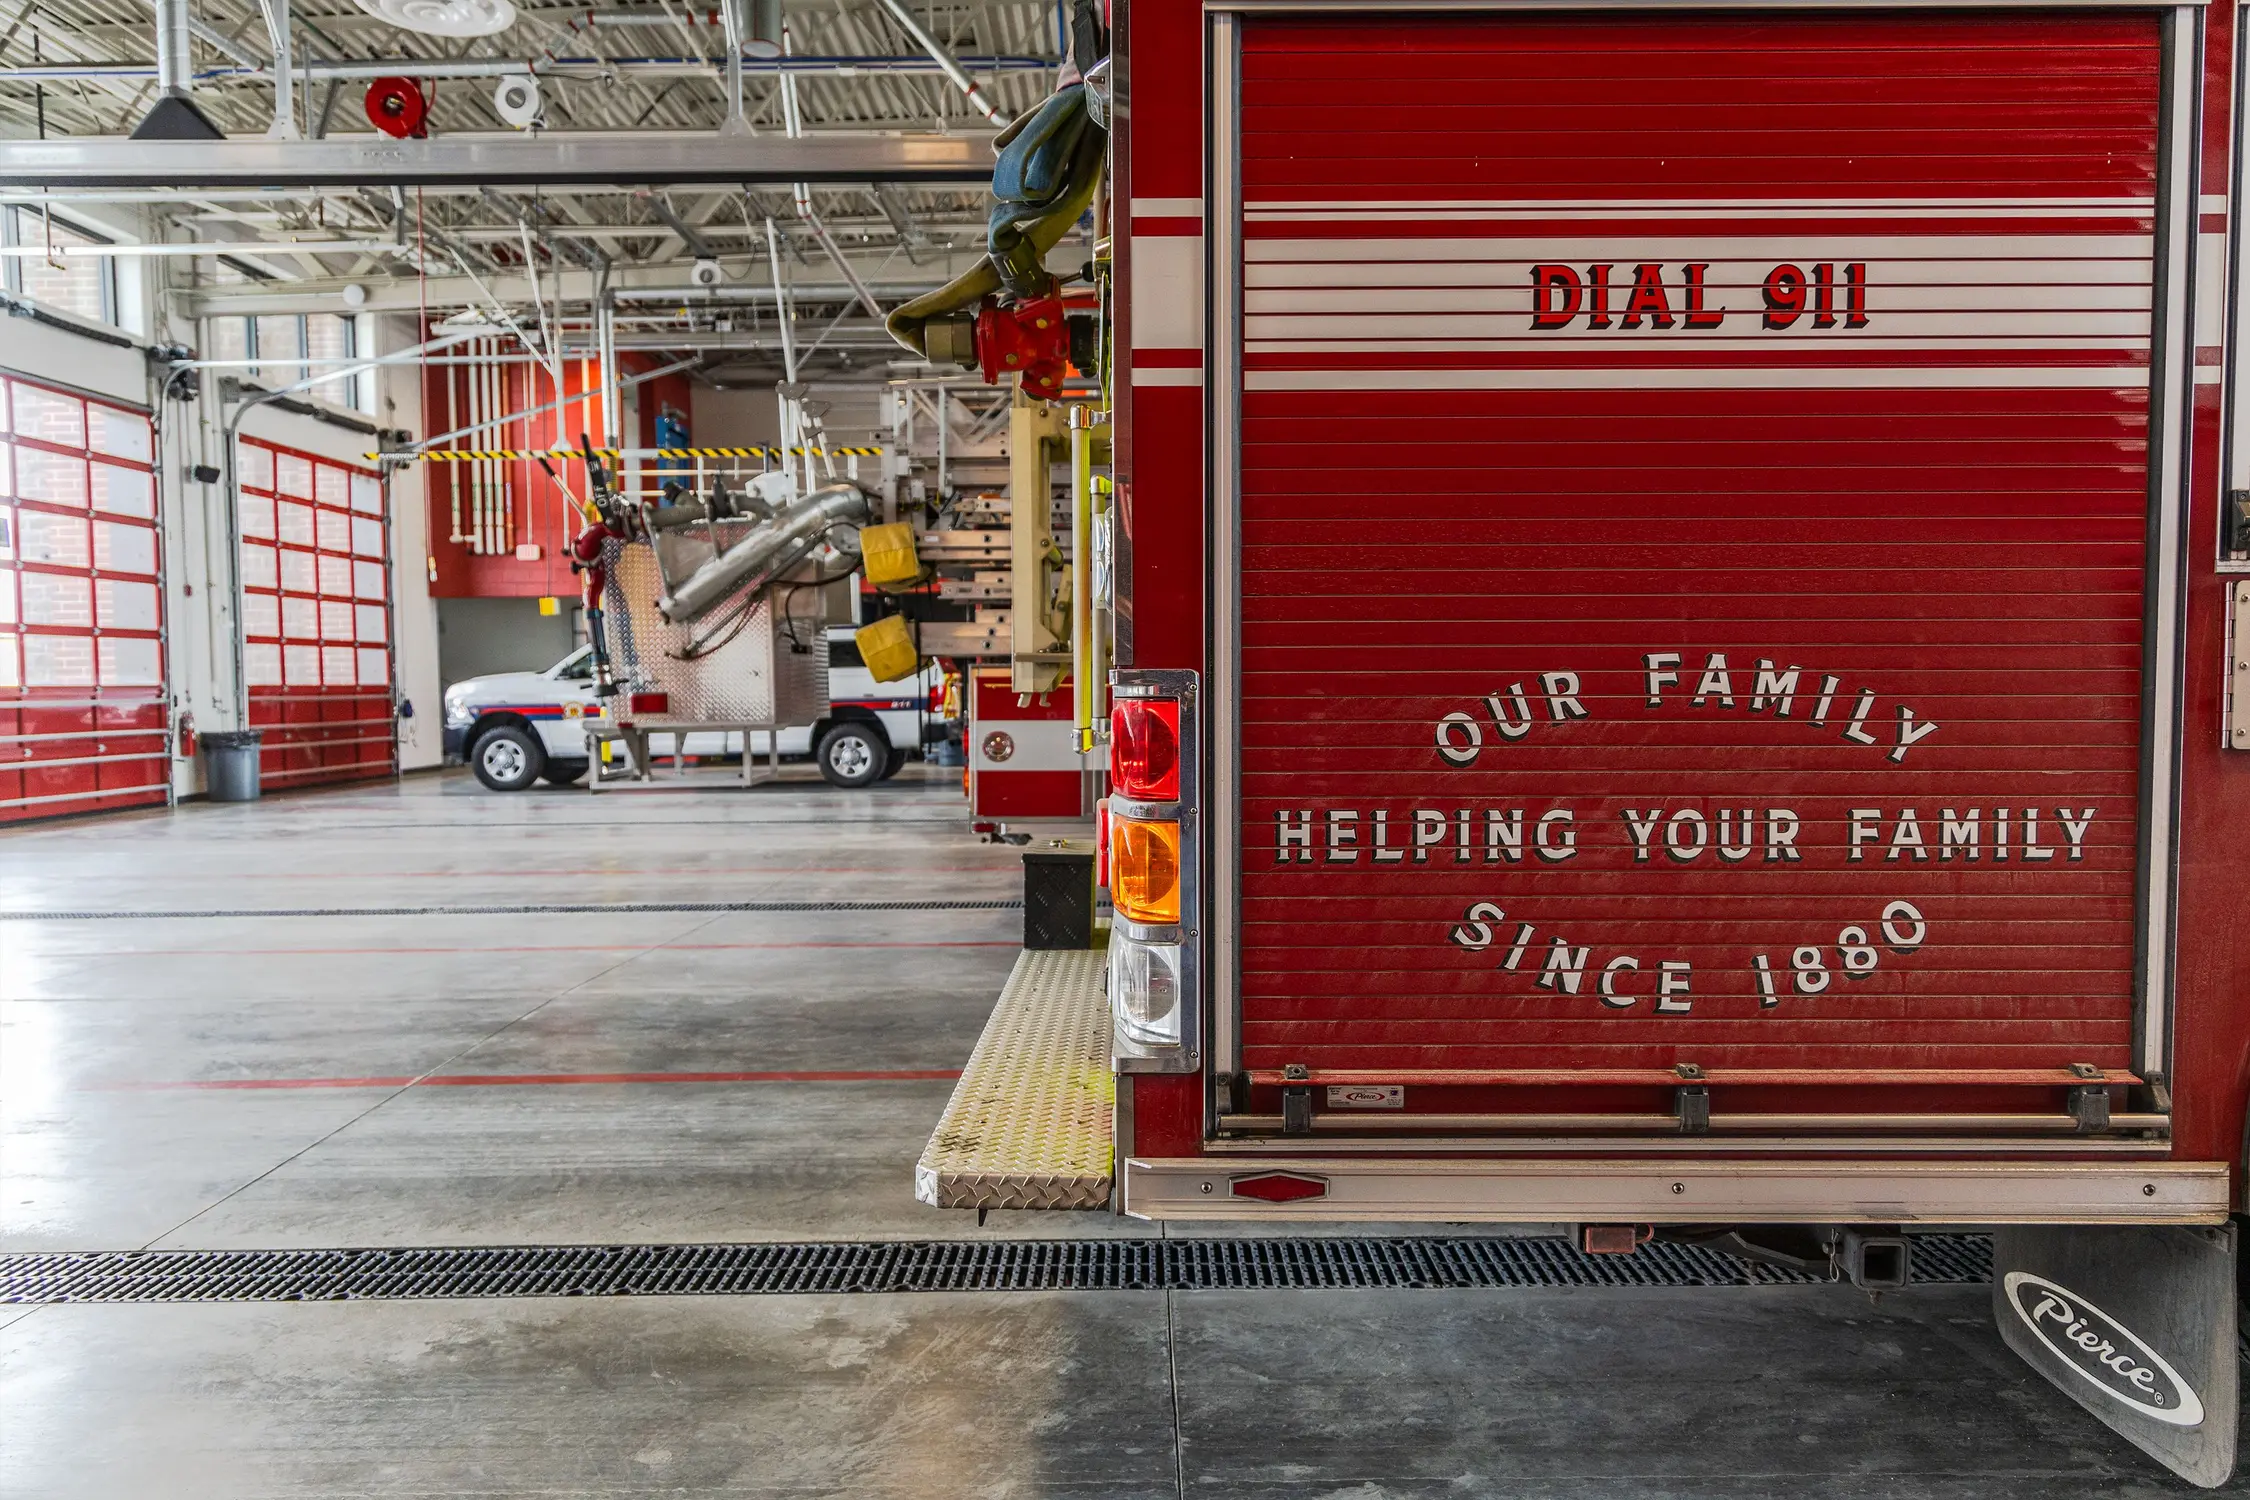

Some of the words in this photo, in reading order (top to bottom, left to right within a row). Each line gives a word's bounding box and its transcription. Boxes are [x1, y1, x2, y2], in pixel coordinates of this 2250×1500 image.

[1529, 264, 1725, 331] DIAL
[1762, 263, 1870, 331] 911
[593, 484, 609, 509] OFF
[1434, 668, 1591, 768] OUR
[1640, 651, 1939, 764] FAMILY
[1274, 808, 1579, 864] HELPING
[1619, 808, 1801, 864] YOUR
[1845, 807, 2098, 863] FAMILY
[1447, 901, 1693, 1015] SINCE
[1751, 899, 1928, 1009] 1880
[2032, 1290, 2157, 1395] Pierce
